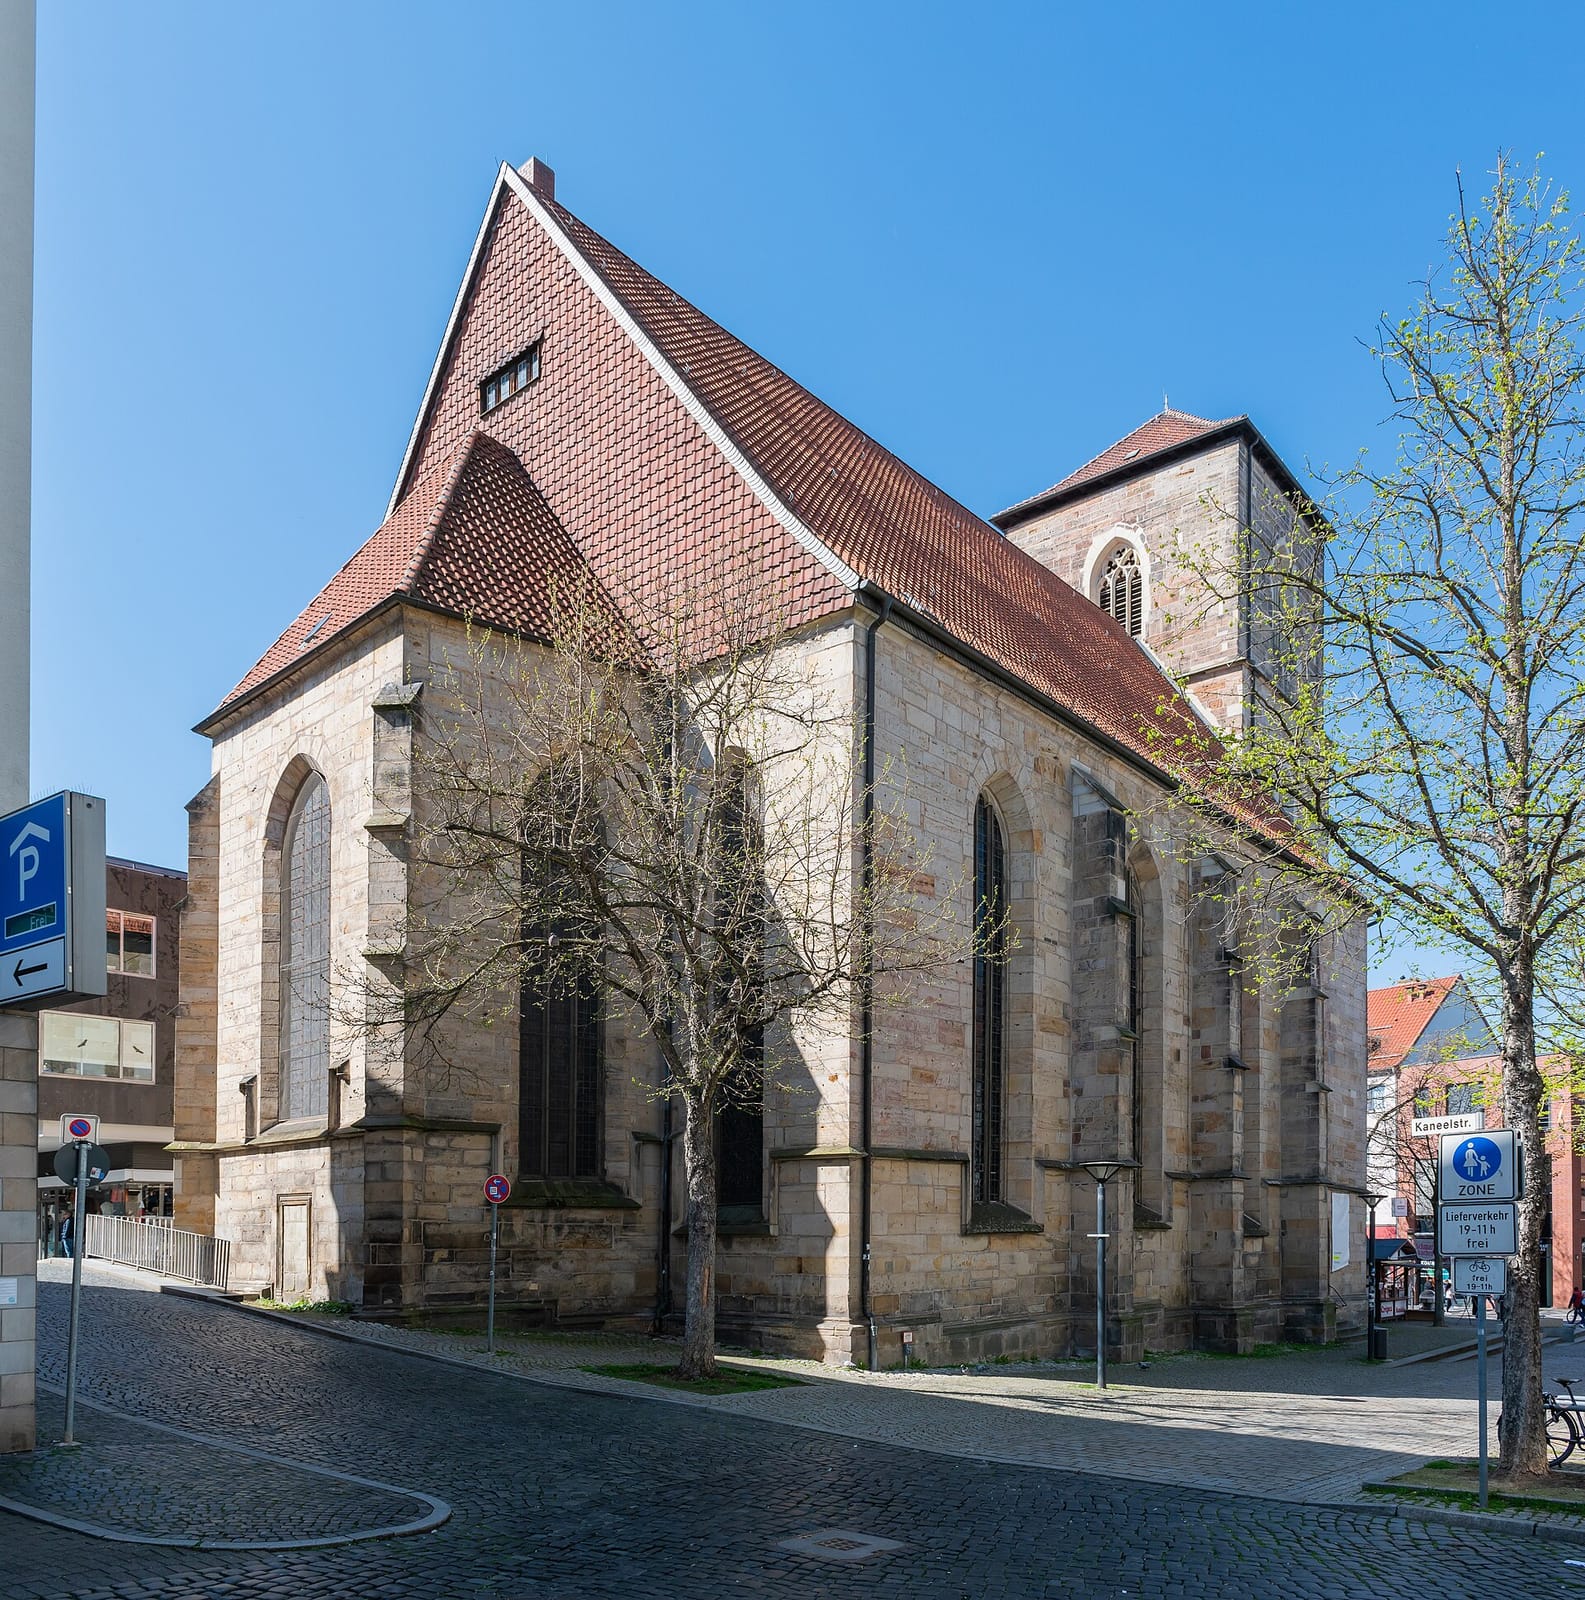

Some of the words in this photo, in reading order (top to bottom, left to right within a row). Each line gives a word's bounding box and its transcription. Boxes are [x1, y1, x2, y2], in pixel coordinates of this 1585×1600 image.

[19, 845, 40, 902] P
[1415, 1119, 1471, 1132] Kaneelstr.
[1458, 1184, 1496, 1196] ZONE
[1445, 1210, 1509, 1222] Lieferverkehr
[1467, 1238, 1489, 1249] frei
[1472, 1274, 1488, 1282] frei
